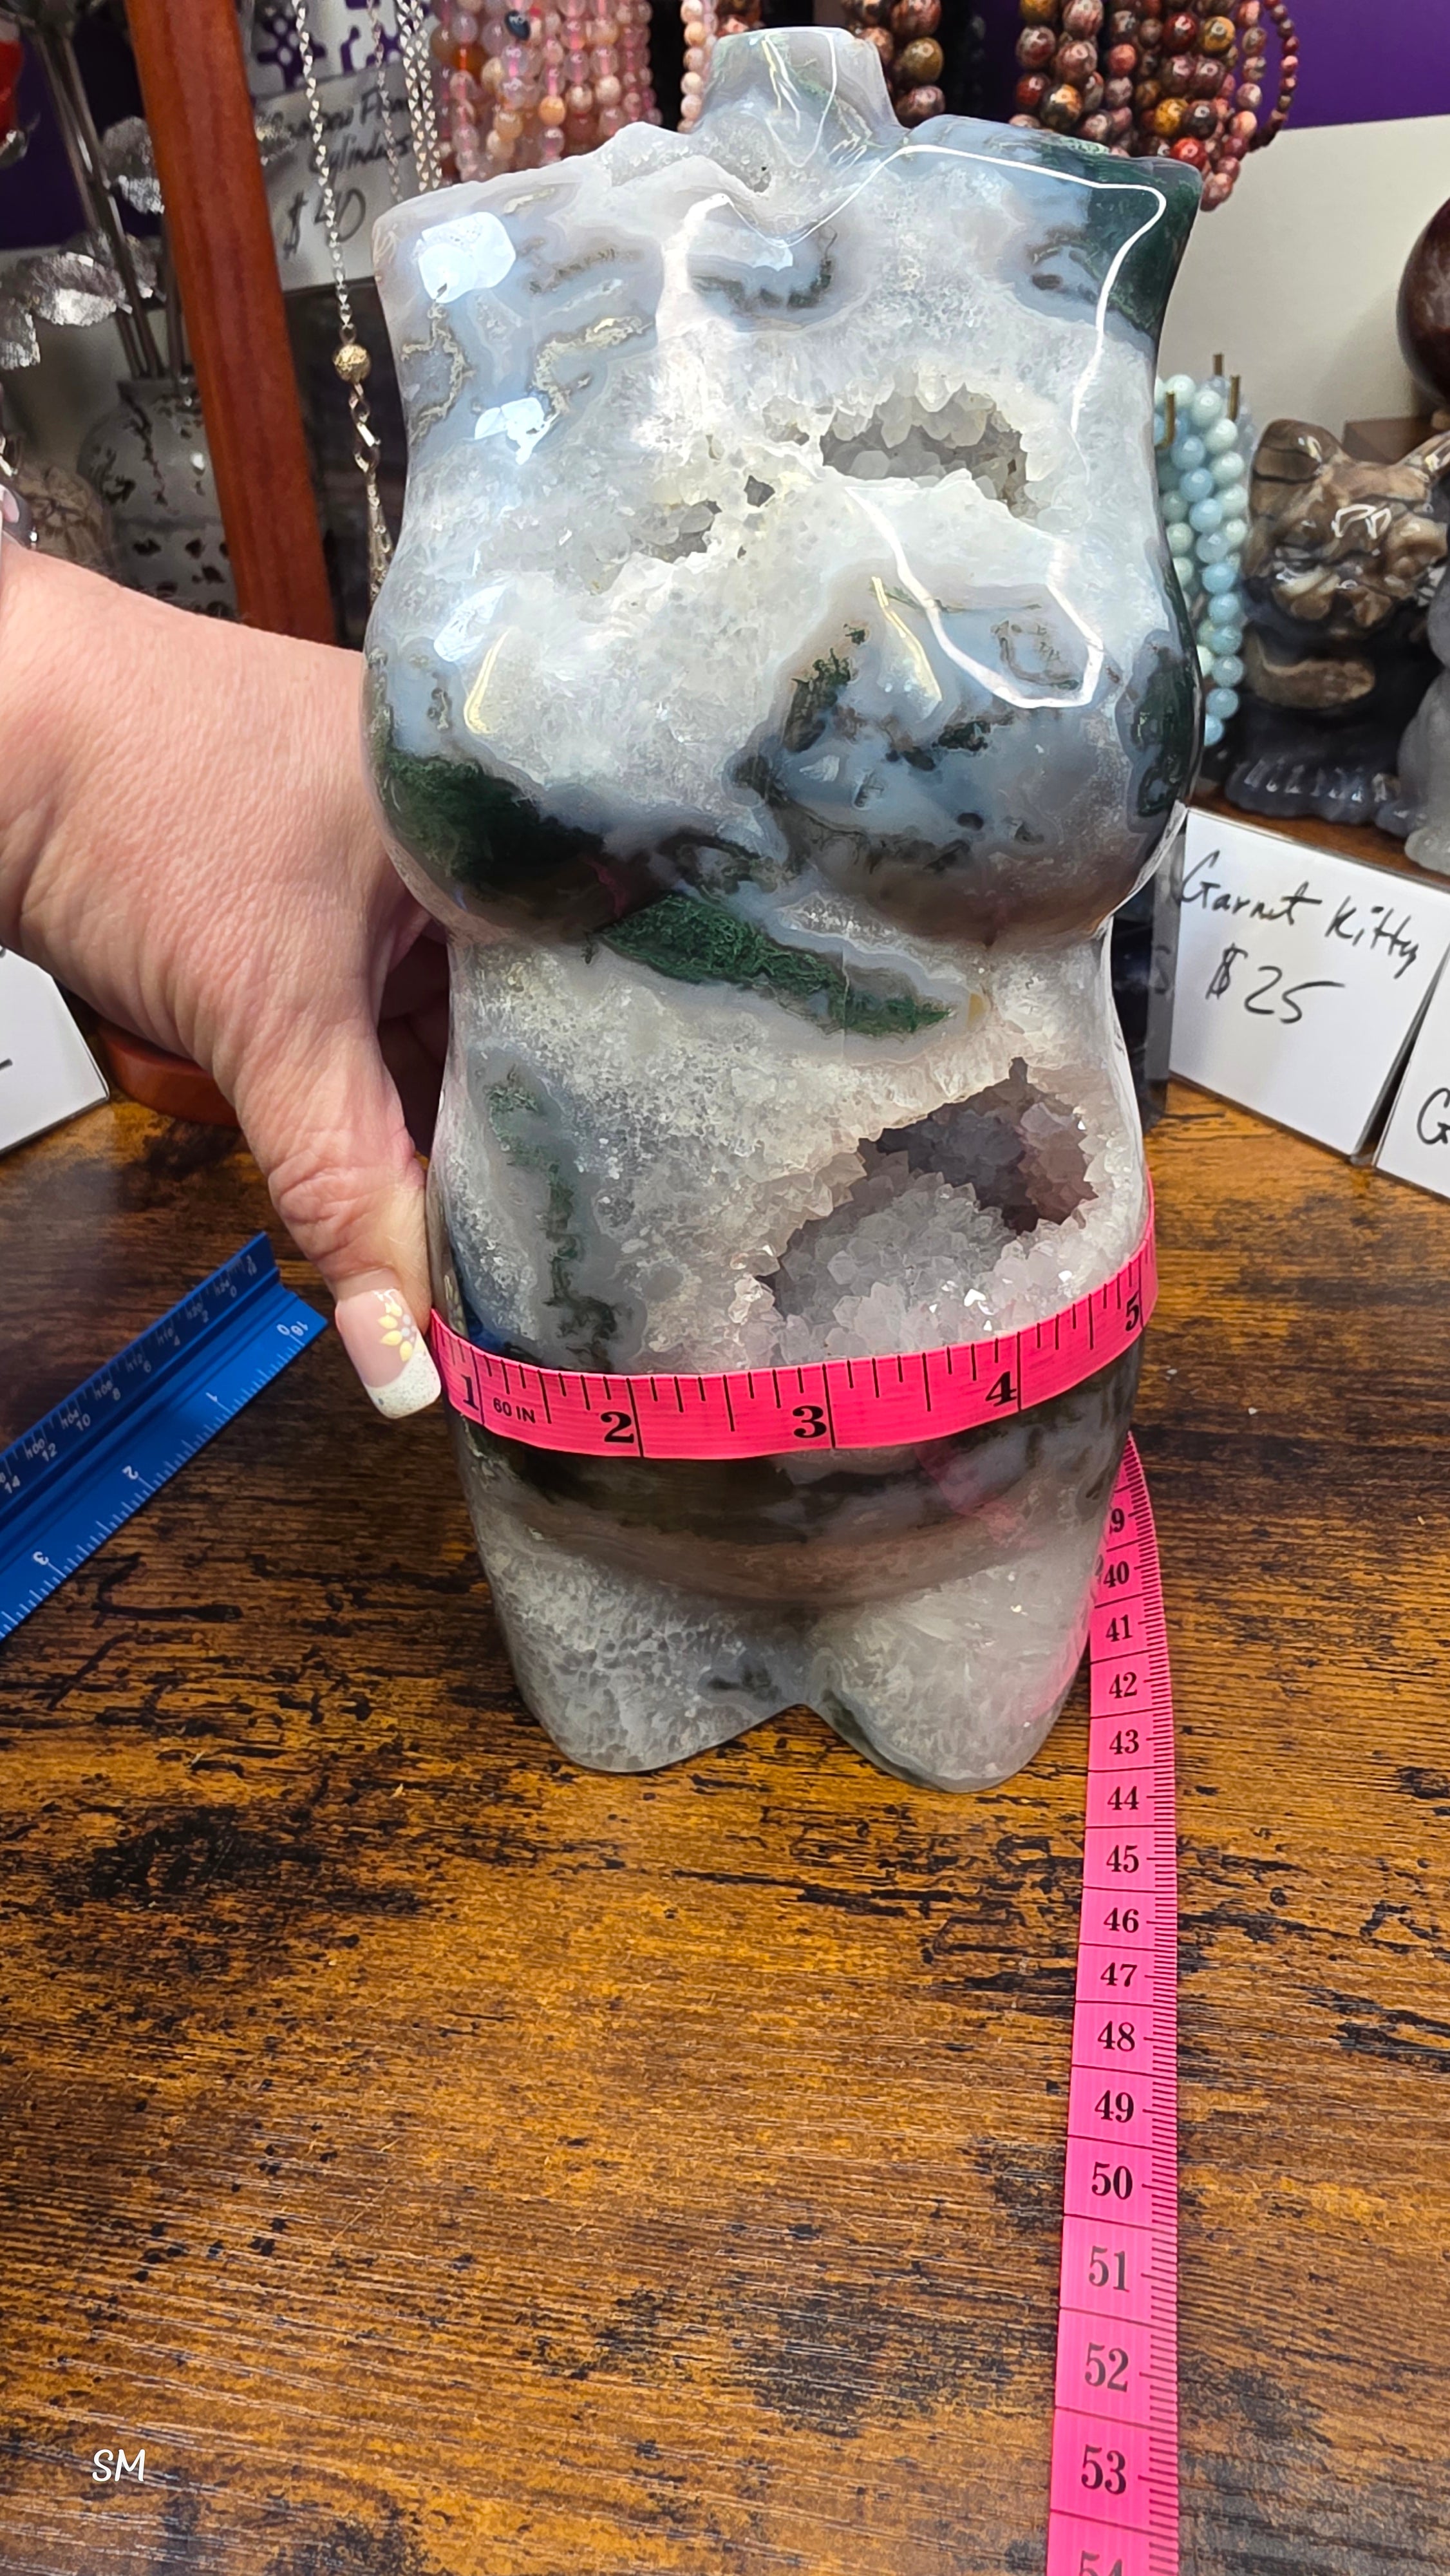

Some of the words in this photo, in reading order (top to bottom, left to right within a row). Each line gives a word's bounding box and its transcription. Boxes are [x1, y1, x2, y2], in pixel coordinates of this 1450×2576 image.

[1125, 1291, 1140, 1331] 5
[461, 1376, 479, 1410] 1
[986, 1371, 1017, 1406] 4
[493, 1399, 512, 1417] 60
[516, 1406, 536, 1423] IN
[793, 1405, 827, 1438] 3
[600, 1410, 634, 1444] 2
[42, 1443, 57, 1462] 12
[122, 1466, 139, 1479] 2
[1109, 1508, 1125, 1534] 9
[32, 1551, 50, 1566] 3
[1104, 1561, 1130, 1588] 40
[1106, 1615, 1133, 1642] 41
[1109, 1672, 1138, 1700] 42
[1109, 1729, 1139, 1756] 43
[1107, 1786, 1139, 1811] 44
[1106, 1844, 1139, 1873] 45
[1103, 1907, 1140, 1933] 46
[1100, 1962, 1138, 1987] 47
[1097, 2021, 1135, 2051] 48
[1095, 2090, 1135, 2123] 49
[1091, 2162, 1133, 2200] 50
[1088, 2245, 1129, 2293] 51
[1084, 2342, 1129, 2392] 52
[1081, 2444, 1127, 2495] 53
